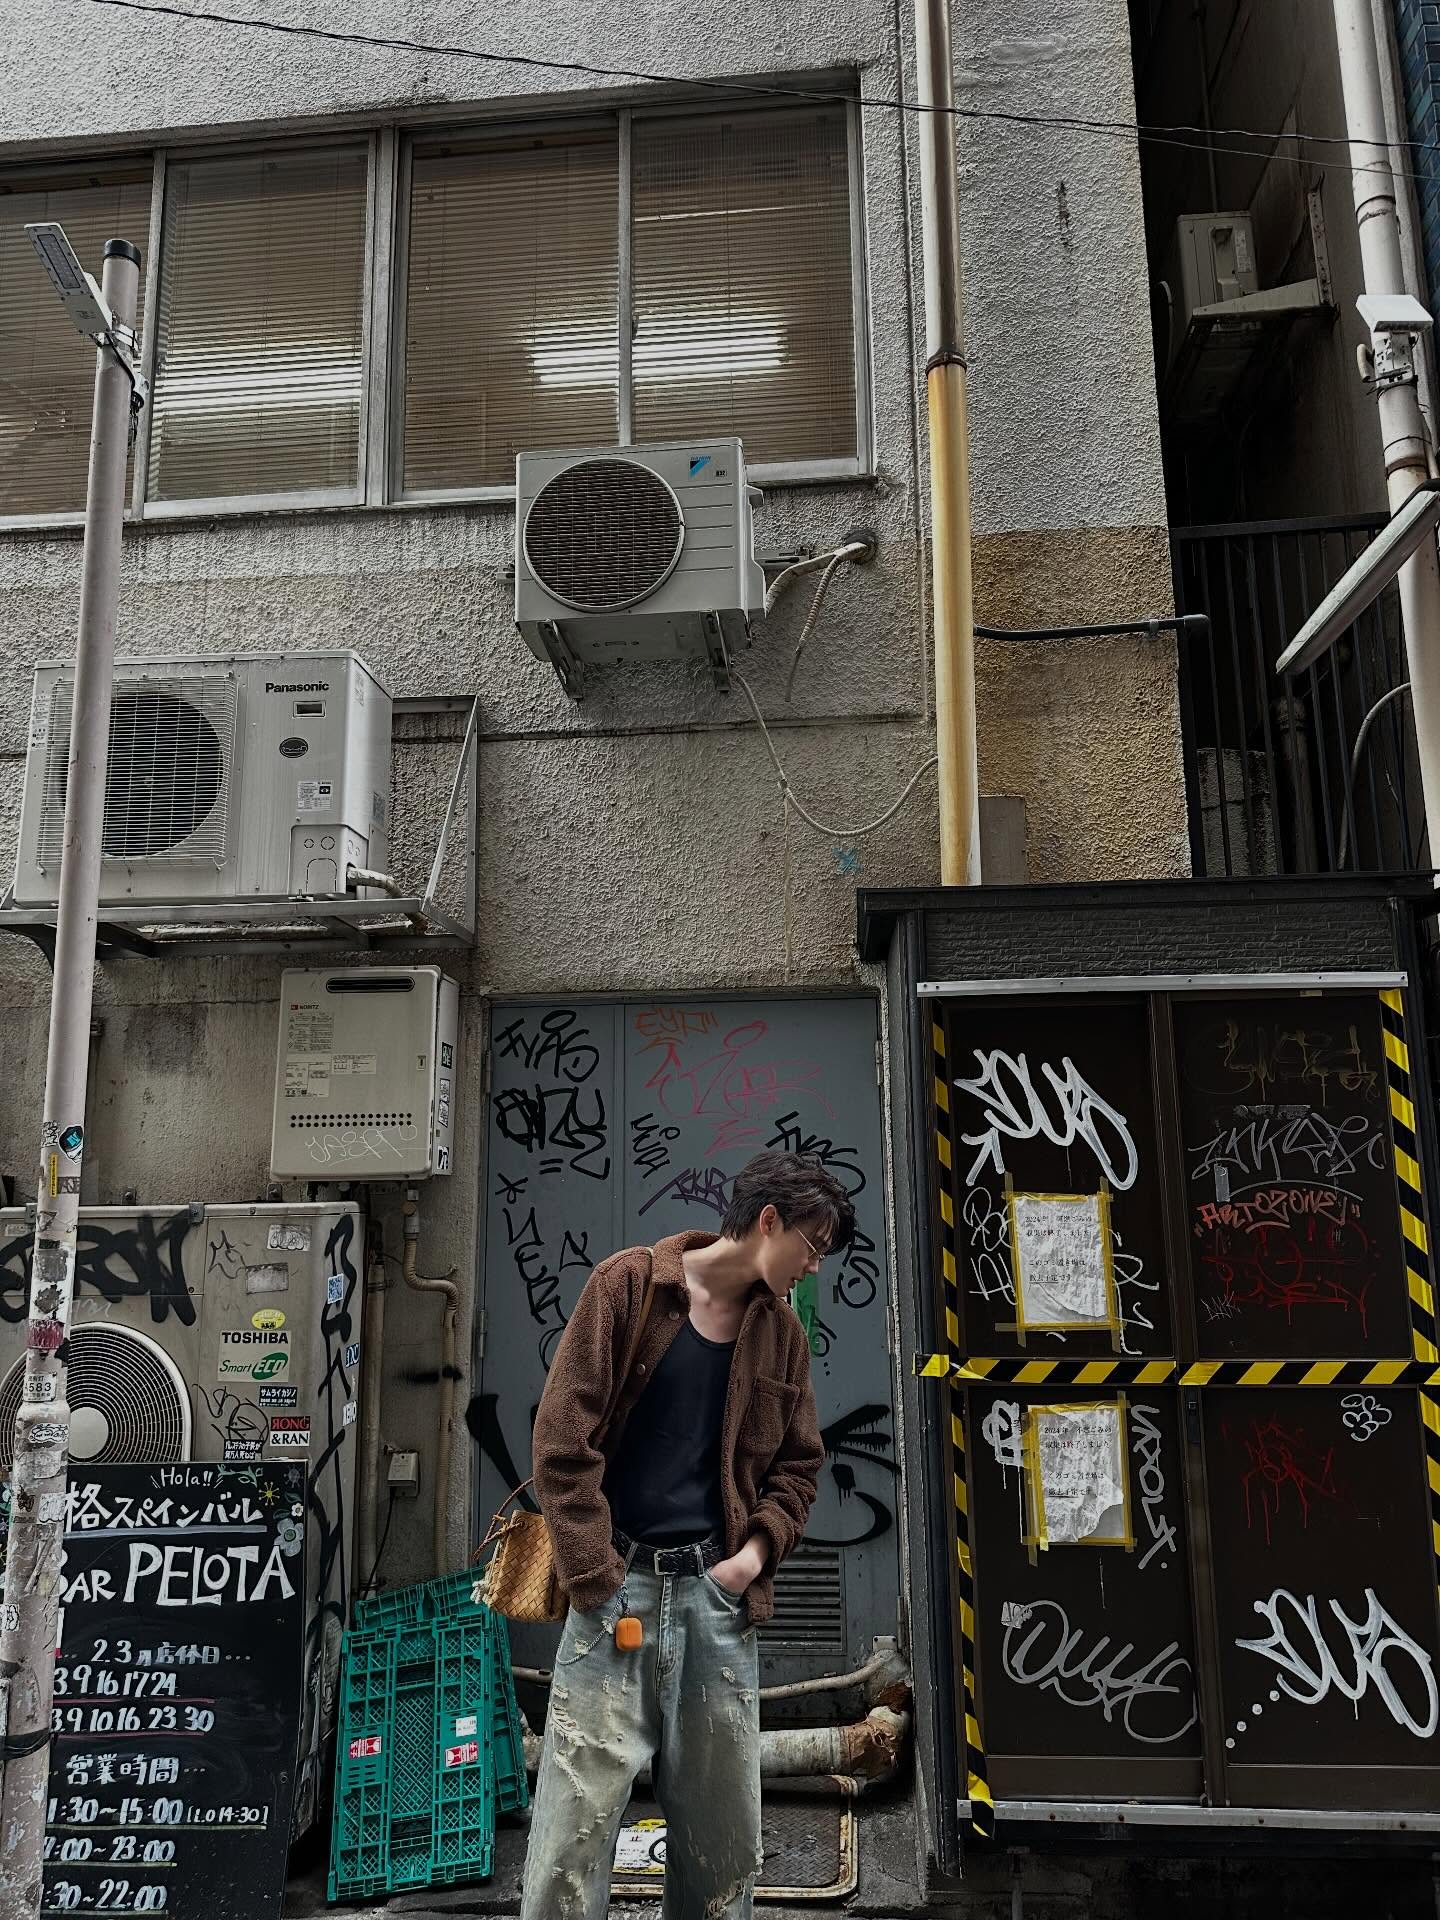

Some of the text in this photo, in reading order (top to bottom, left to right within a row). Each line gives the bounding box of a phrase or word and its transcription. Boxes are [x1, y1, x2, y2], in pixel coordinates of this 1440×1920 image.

[265, 681, 330, 693] Panasonic
[222, 1332, 289, 1344] TOSHIBA
[219, 1360, 287, 1373] Smart ECO
[260, 1388, 297, 1398] サムライカジノ
[123, 1542, 296, 1606] PELOTA
